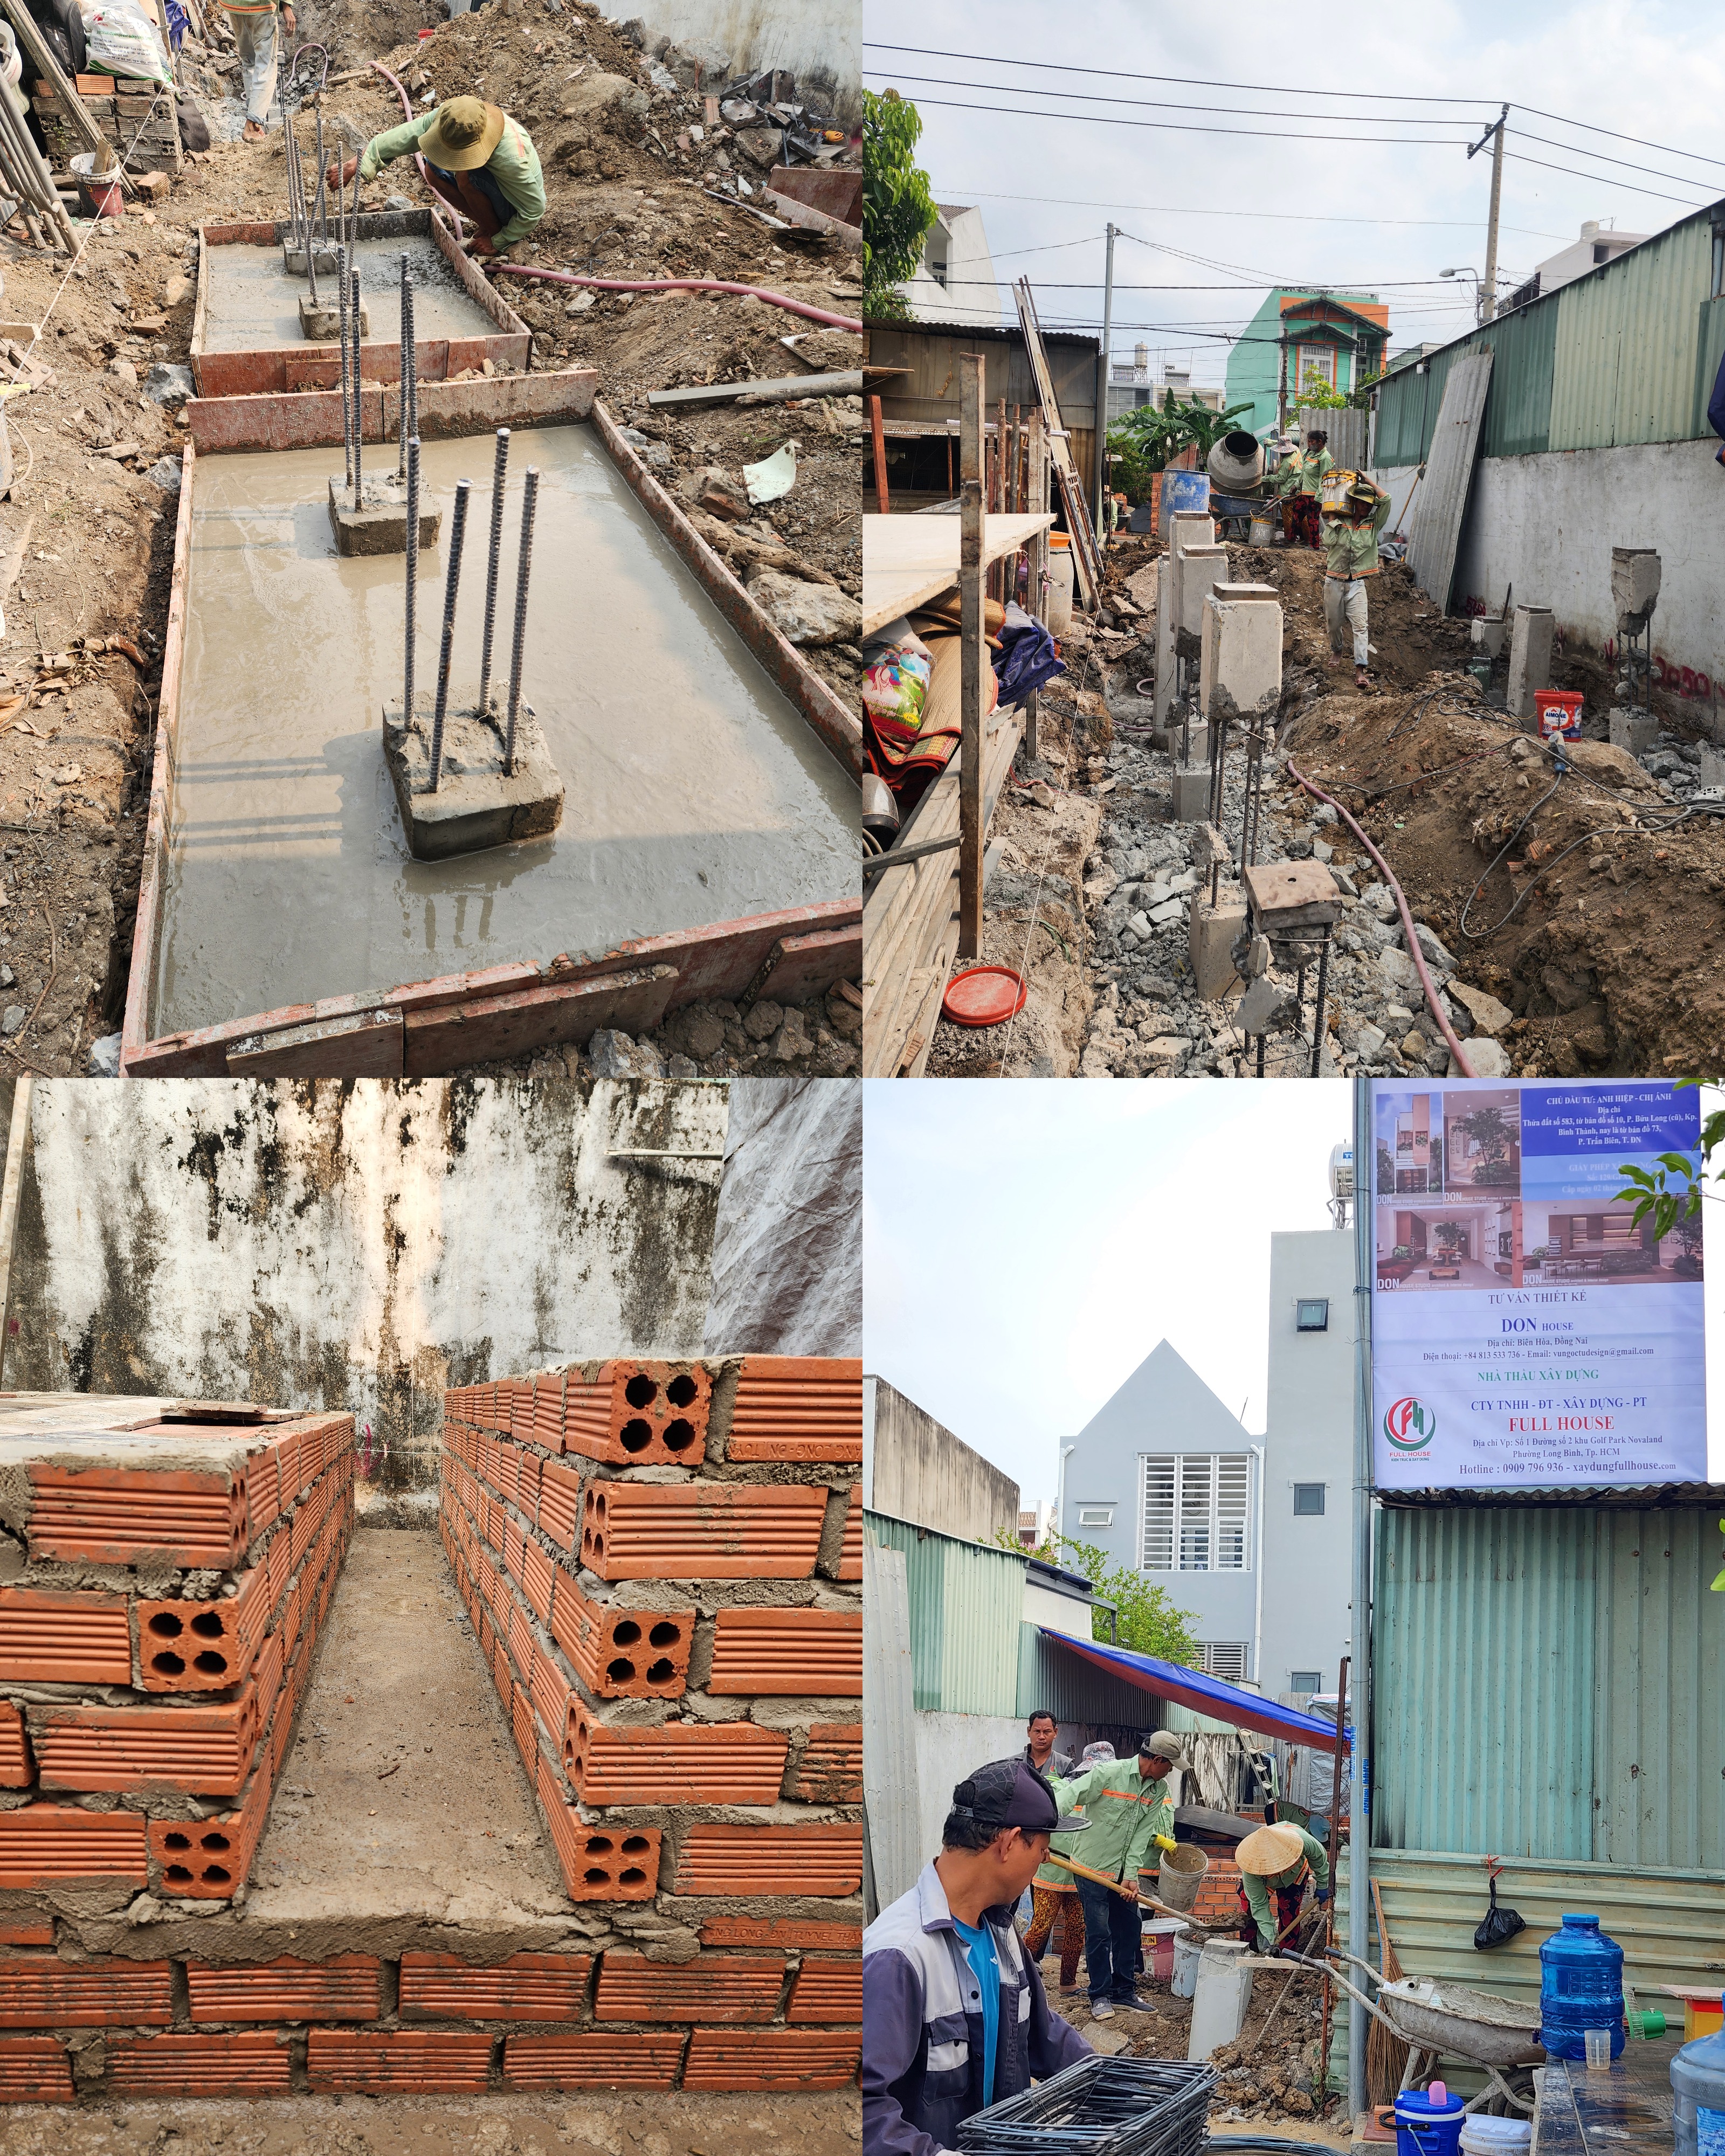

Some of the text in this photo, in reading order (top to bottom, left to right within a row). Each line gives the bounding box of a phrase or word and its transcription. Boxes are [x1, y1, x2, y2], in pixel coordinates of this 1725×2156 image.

[1547, 1096, 1563, 1105] CHỦ
[1582, 1096, 1596, 1104] TƯ:
[1597, 1095, 1613, 1103] ANH
[1615, 1094, 1633, 1103] HIỆP
[1598, 1107, 1609, 1115] Địa
[1541, 1117, 1551, 1126] đất
[1553, 1116, 1560, 1125] số
[1561, 1117, 1575, 1126] 583,
[1607, 1115, 1614, 1124] số
[1616, 1116, 1625, 1124] 10,
[1651, 1115, 1668, 1123] Long
[1685, 1113, 1698, 1122] Kp.
[1377, 1194, 1392, 1205] DON
[1444, 1192, 1462, 1202] DON
[1377, 1278, 1399, 1289] DON
[1523, 1274, 1542, 1284] DON
[1488, 1289, 1587, 1304] TƯ VẤN THIẾT KẾ
[1501, 1317, 1574, 1332] DON HOUSE
[1487, 1339, 1500, 1349] Địa
[1517, 1338, 1533, 1346] Biên
[1535, 1338, 1552, 1346] Hòa,
[1554, 1335, 1573, 1346] Đồng
[1423, 1352, 1439, 1362] Điện
[1441, 1352, 1461, 1362] thoại:
[1464, 1351, 1476, 1359] +84
[1493, 1351, 1506, 1359] 533
[1527, 1350, 1551, 1358] Email:
[1553, 1348, 1654, 1358] vungoctudesign@gmail.com
[1478, 1369, 1501, 1381] NHÀ
[1539, 1367, 1563, 1380] XÂY
[1565, 1368, 1599, 1382] DỰNG
[1471, 1396, 1647, 1411] CTY TNHH ĐT XÂY DỰNG PT
[1508, 1416, 1614, 1432] FULL HOUSE
[1473, 1439, 1485, 1449] Địa
[1500, 1439, 1513, 1448] Vp:
[1515, 1436, 1524, 1446] Số
[1532, 1438, 1557, 1447] Đường
[1558, 1435, 1567, 1445] số
[1628, 1435, 1663, 1443] Novaland
[797, 1443, 831, 1458] LONG
[1513, 1448, 1620, 1459] Phường Long Bình, Tp. HCM
[1460, 1461, 1676, 1474] Hotline 0909 796 936 xaydungfullhouse.com
[721, 1729, 753, 1742] LONG
[734, 1929, 763, 1939] LONG
[770, 1930, 786, 1940] ĐN
[794, 1931, 833, 1941] TUYNEL
[837, 1931, 862, 1943] THĂN
